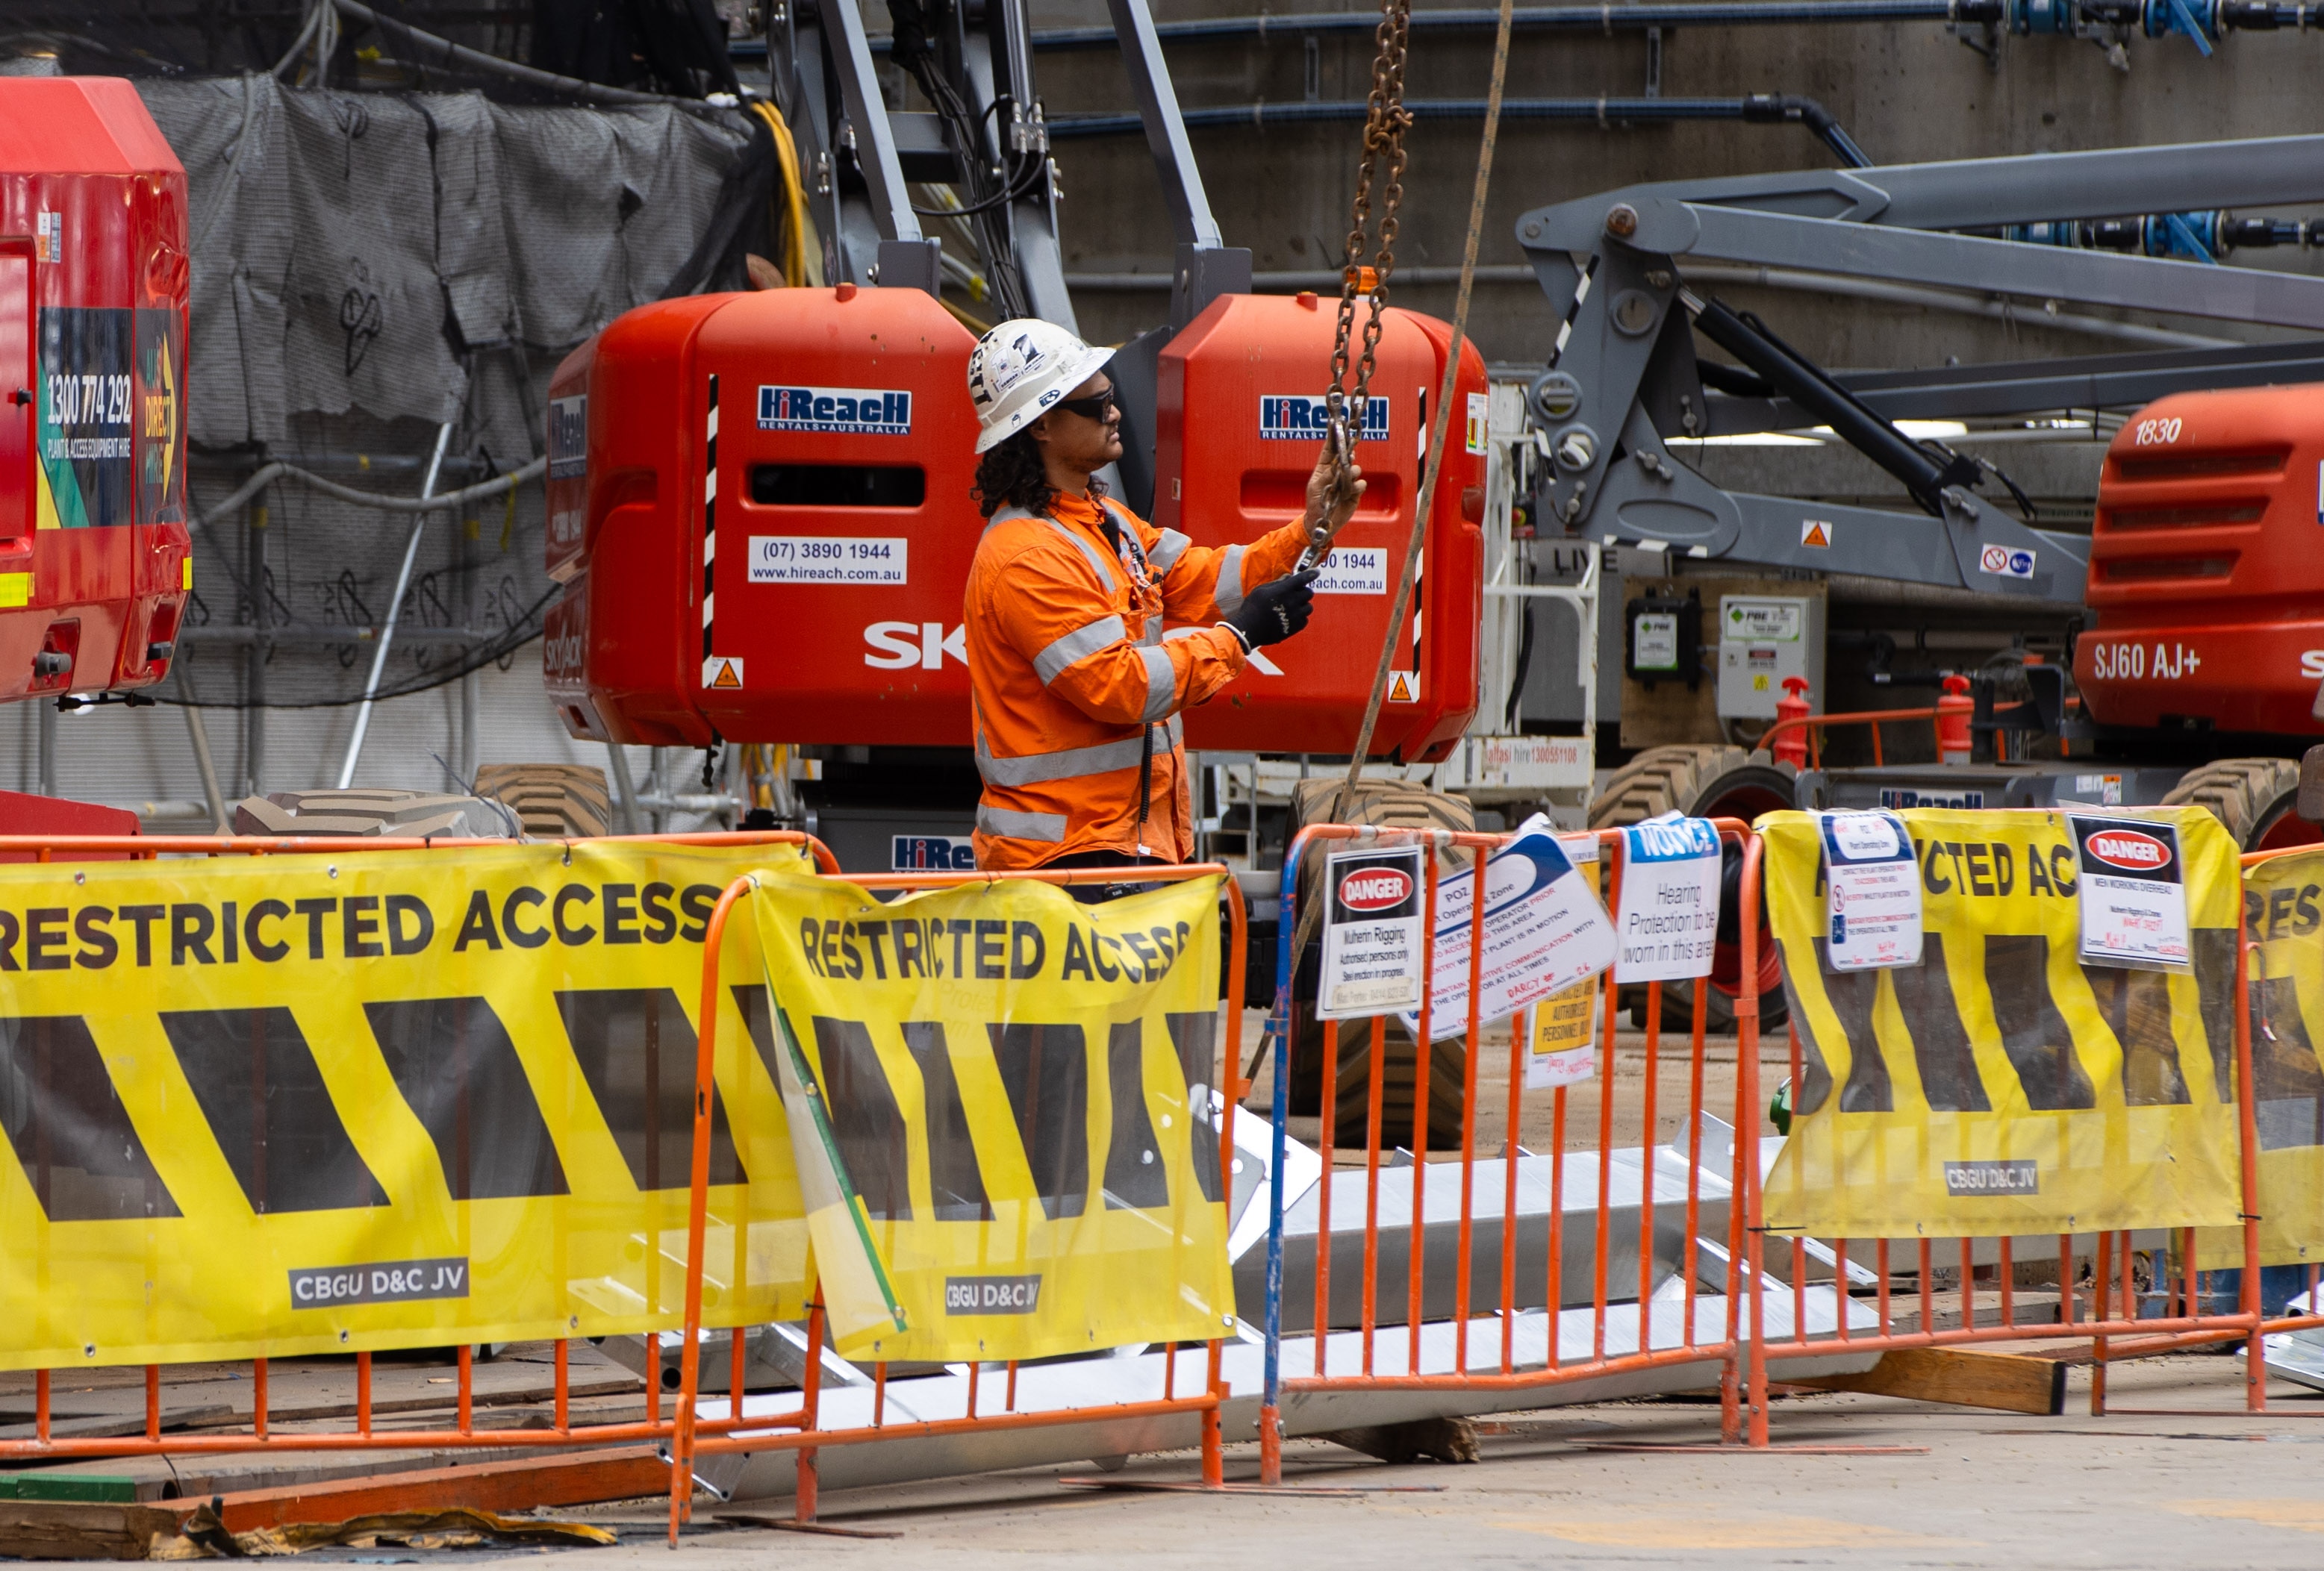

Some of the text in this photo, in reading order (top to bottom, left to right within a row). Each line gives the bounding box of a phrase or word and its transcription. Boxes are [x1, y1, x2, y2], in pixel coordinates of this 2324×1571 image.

[48, 375, 131, 424] 1300 774 292
[146, 396, 171, 438] DIRECT
[1263, 399, 1387, 429] HiReH
[2136, 416, 2183, 446] 1830
[48, 439, 64, 460] PLANT
[69, 439, 87, 459] ACCESS
[88, 438, 119, 460] EQUIPMENT
[119, 437, 131, 458] HIRE
[764, 543, 891, 561] (07) 3890 1944
[1343, 553, 1375, 569] 1944
[1554, 547, 1619, 575] LIVE
[753, 566, 901, 581] www.hireach.com.au
[2094, 642, 2202, 680] SJ60 AJ+
[1514, 745, 1531, 764] hire
[2096, 837, 2161, 863] DANGER
[1345, 877, 1404, 902] DANGER
[1445, 886, 1471, 904] POZ
[1490, 882, 1515, 901] Zone
[1657, 881, 1702, 908] Hearing
[2110, 878, 2140, 891] WORKING
[2140, 881, 2173, 895] OVERHEAD
[0, 882, 723, 971] RESTRICTED ACCESS
[1439, 934, 1457, 949] THE
[1486, 902, 1530, 928] OPERATOR
[1530, 887, 1557, 907] PRIOR
[1489, 933, 1516, 952] PLANT
[1517, 930, 1526, 940] IS
[1527, 925, 1536, 937] IN
[1536, 908, 1570, 931] MOTION
[1492, 922, 1513, 937] THIS
[1513, 911, 1536, 928] AREA
[1630, 908, 1715, 935] Protection to be
[800, 917, 1046, 980] RESTRICTED
[1374, 925, 1406, 946] Rigging
[1505, 932, 1574, 970] COMMUNICATION
[1573, 919, 1596, 935] WITH
[1339, 947, 1409, 965] Authorised persons only
[1624, 944, 1657, 963] worn
[1659, 940, 1670, 962] in
[1674, 937, 1694, 961] this
[1434, 995, 1451, 1007] THE
[1495, 974, 1507, 986] AT
[1507, 967, 1524, 982] ALL
[1524, 955, 1551, 973] TIMES
[1947, 1167, 2036, 1188] CBGU D&C JV
[295, 1266, 464, 1301] CBGU D&C JV
[947, 1284, 979, 1308] CBGU
[983, 1284, 1026, 1306] D&C
